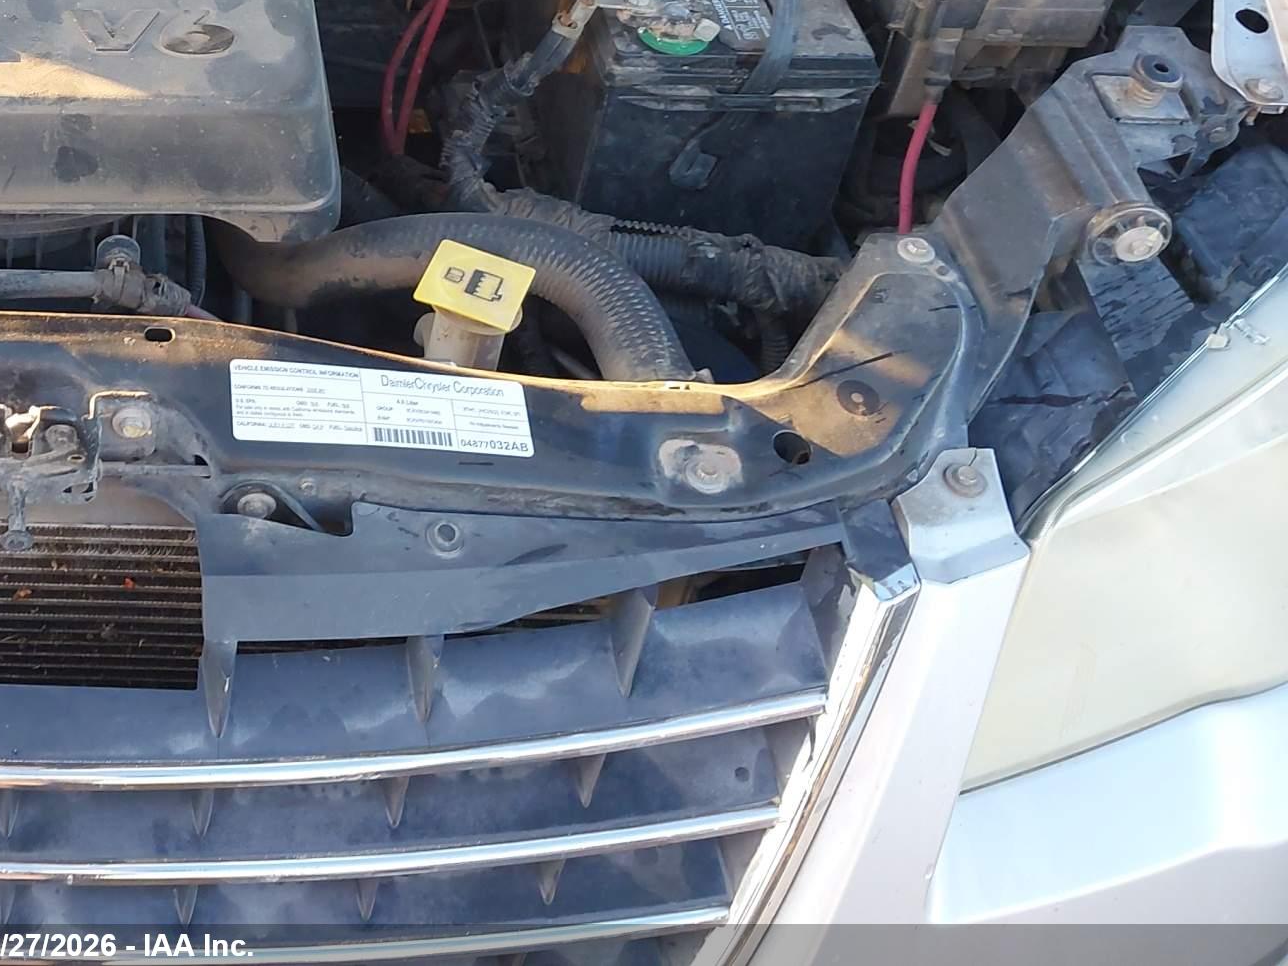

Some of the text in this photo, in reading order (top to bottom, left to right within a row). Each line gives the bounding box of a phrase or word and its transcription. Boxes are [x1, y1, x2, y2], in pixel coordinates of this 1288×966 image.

[64, 8, 235, 55] V6
[260, 365, 288, 373] EMISSION
[289, 367, 318, 375] CONTROL
[319, 370, 359, 378] INFORMATION
[380, 374, 505, 397] DaimlerChrysler Corporation
